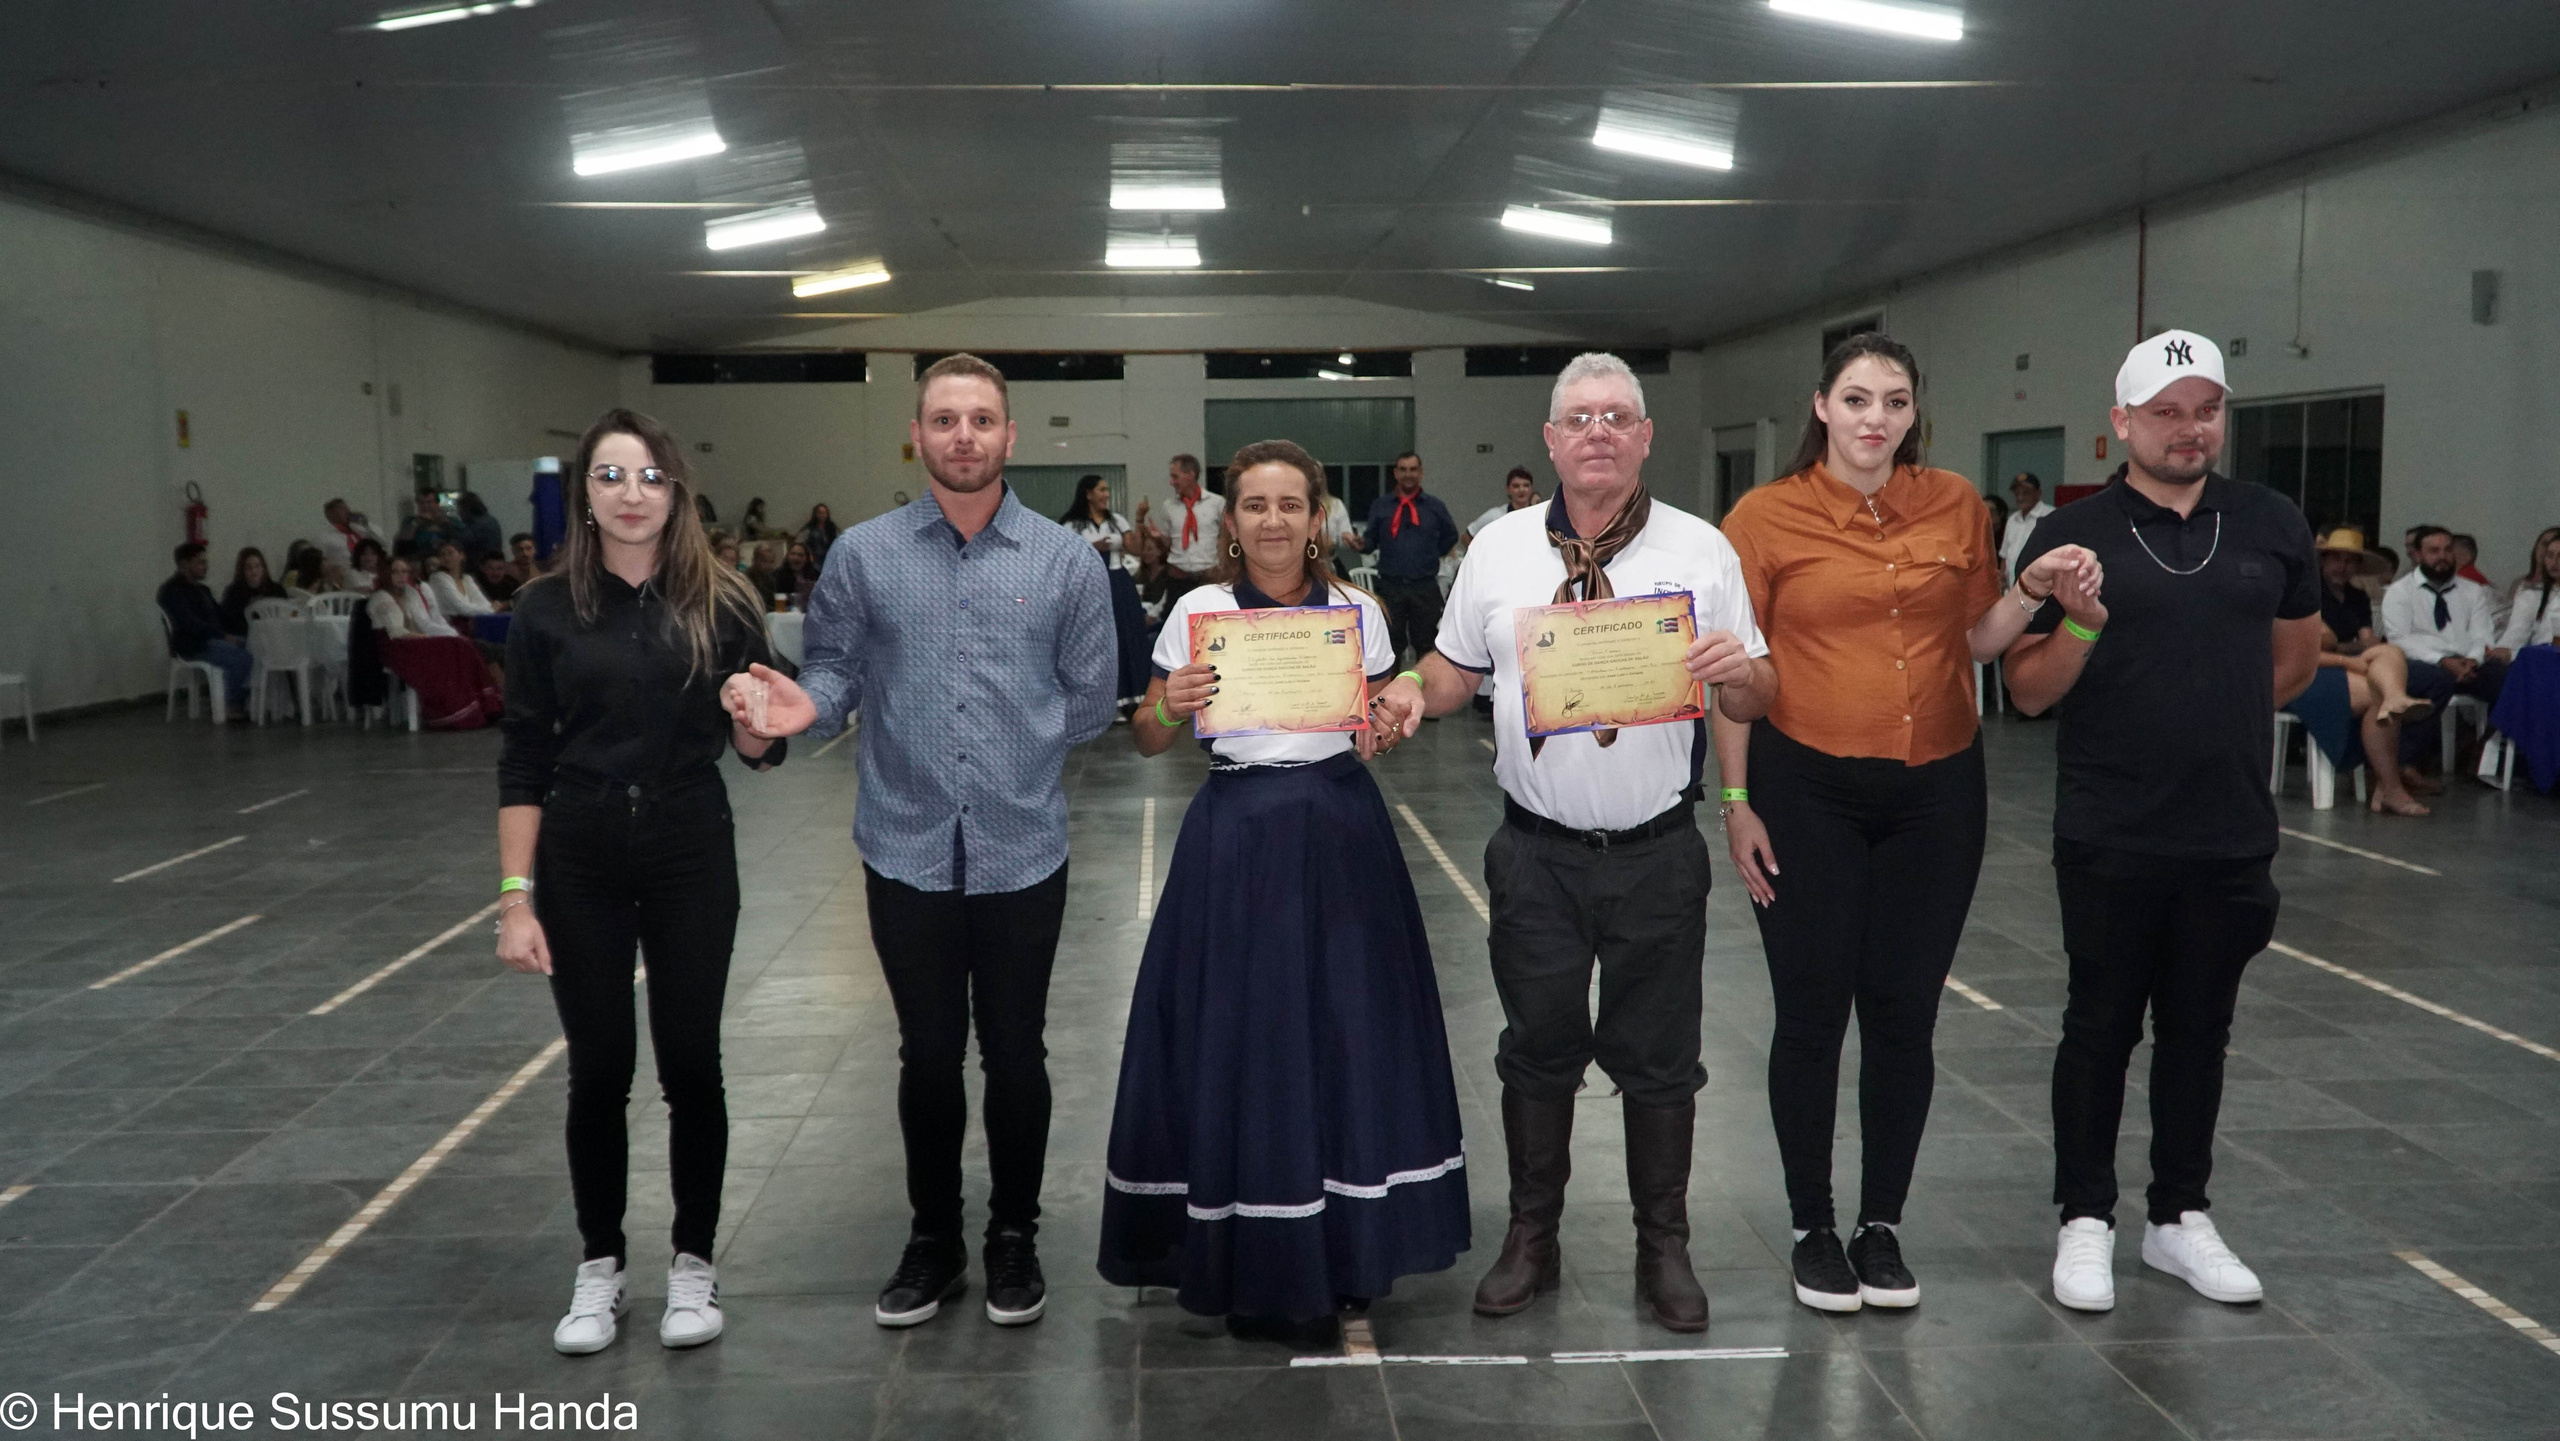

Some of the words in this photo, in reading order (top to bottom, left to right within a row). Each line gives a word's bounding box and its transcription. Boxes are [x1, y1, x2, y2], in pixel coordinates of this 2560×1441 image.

[2164, 339, 2194, 367] NY
[1573, 621, 1643, 636] CERTIFICADO
[1244, 631, 1311, 642] CERTIFICADO
